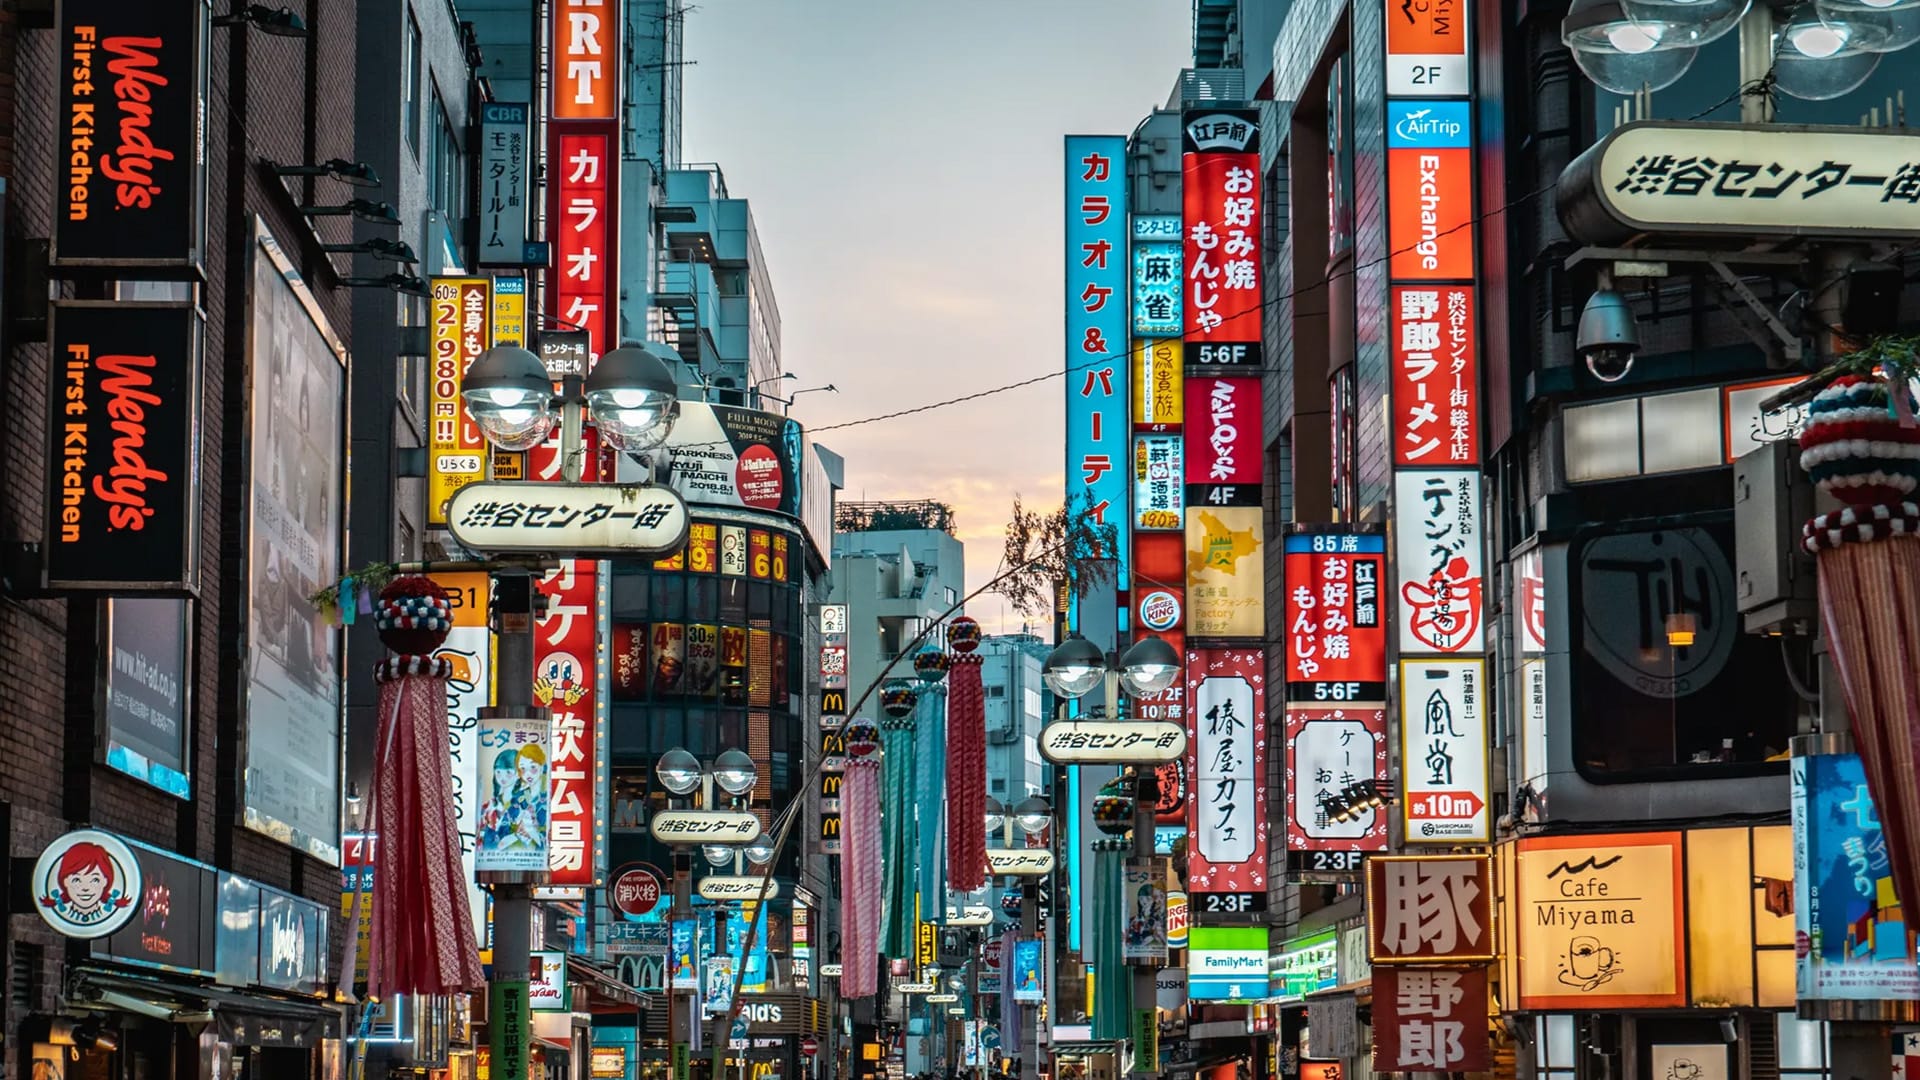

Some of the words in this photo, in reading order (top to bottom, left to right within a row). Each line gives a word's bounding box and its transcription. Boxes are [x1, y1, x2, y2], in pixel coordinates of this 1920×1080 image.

[72, 25, 96, 97] First
[567, 0, 602, 104] RT
[1412, 65, 1441, 84] 2F
[100, 36, 174, 209] Wendy's
[487, 107, 522, 121] CBR
[1194, 122, 1247, 142] 江戸前
[1408, 119, 1460, 138] AirTrip
[69, 103, 95, 221] Kitchen
[509, 132, 521, 207] 渋谷センター街
[488, 131, 506, 247] モニタールーム
[1615, 154, 1920, 204] 渋谷センター街
[1416, 155, 1440, 270] Exchange
[1135, 221, 1182, 234] センタービル
[1224, 167, 1256, 289] お好み焼
[567, 149, 599, 375] カラオケ
[1144, 255, 1172, 320] 麻雀
[1190, 221, 1222, 334] もんじゃ
[435, 285, 458, 299] 60分
[543, 344, 585, 355] センター街
[463, 288, 485, 444] 全身もし
[546, 359, 582, 373] 太田ビル
[1401, 291, 1441, 460] 野郎ラーメン
[66, 344, 90, 415] First
[1152, 424, 1166, 432] 4F
[92, 354, 168, 531] Wendy's
[441, 459, 477, 469] りらくる
[61, 423, 88, 543] Kitchen
[1209, 487, 1236, 505] 4F
[459, 502, 675, 530] 渋谷センター街
[1141, 513, 1179, 528] 190円
[1313, 535, 1358, 552] 85席
[724, 551, 735, 565] 金
[1195, 587, 1229, 597] 北海道
[1355, 563, 1375, 625] 江戸前
[1146, 600, 1173, 613] BURGER
[1147, 606, 1175, 621] KING
[1195, 608, 1236, 619] Factory
[1322, 557, 1350, 660] お好み焼
[689, 627, 716, 643] 30分
[1293, 586, 1319, 679] もんじゃ
[1432, 633, 1451, 648] B1
[478, 724, 511, 748] 七夕
[514, 730, 548, 745] まつり
[1424, 669, 1464, 786] 一風堂
[1050, 732, 1180, 749] 渋谷センター街
[1205, 699, 1245, 842] 椿屋カフェ
[1339, 729, 1357, 808] ケーキ
[1314, 767, 1333, 830] お食事
[1413, 795, 1473, 816] 約10m
[657, 820, 755, 833] 渋谷センター街
[990, 856, 1051, 866] センター街
[619, 884, 657, 902] 消火栓
[1560, 878, 1609, 898] Cafe
[1382, 861, 1482, 955] 豚
[1537, 905, 1636, 930] Miyama
[543, 963, 562, 971] ピザ
[1205, 956, 1264, 968] FamilyMart
[1156, 980, 1185, 990] SUSHI
[1397, 970, 1464, 1068] 野郎
